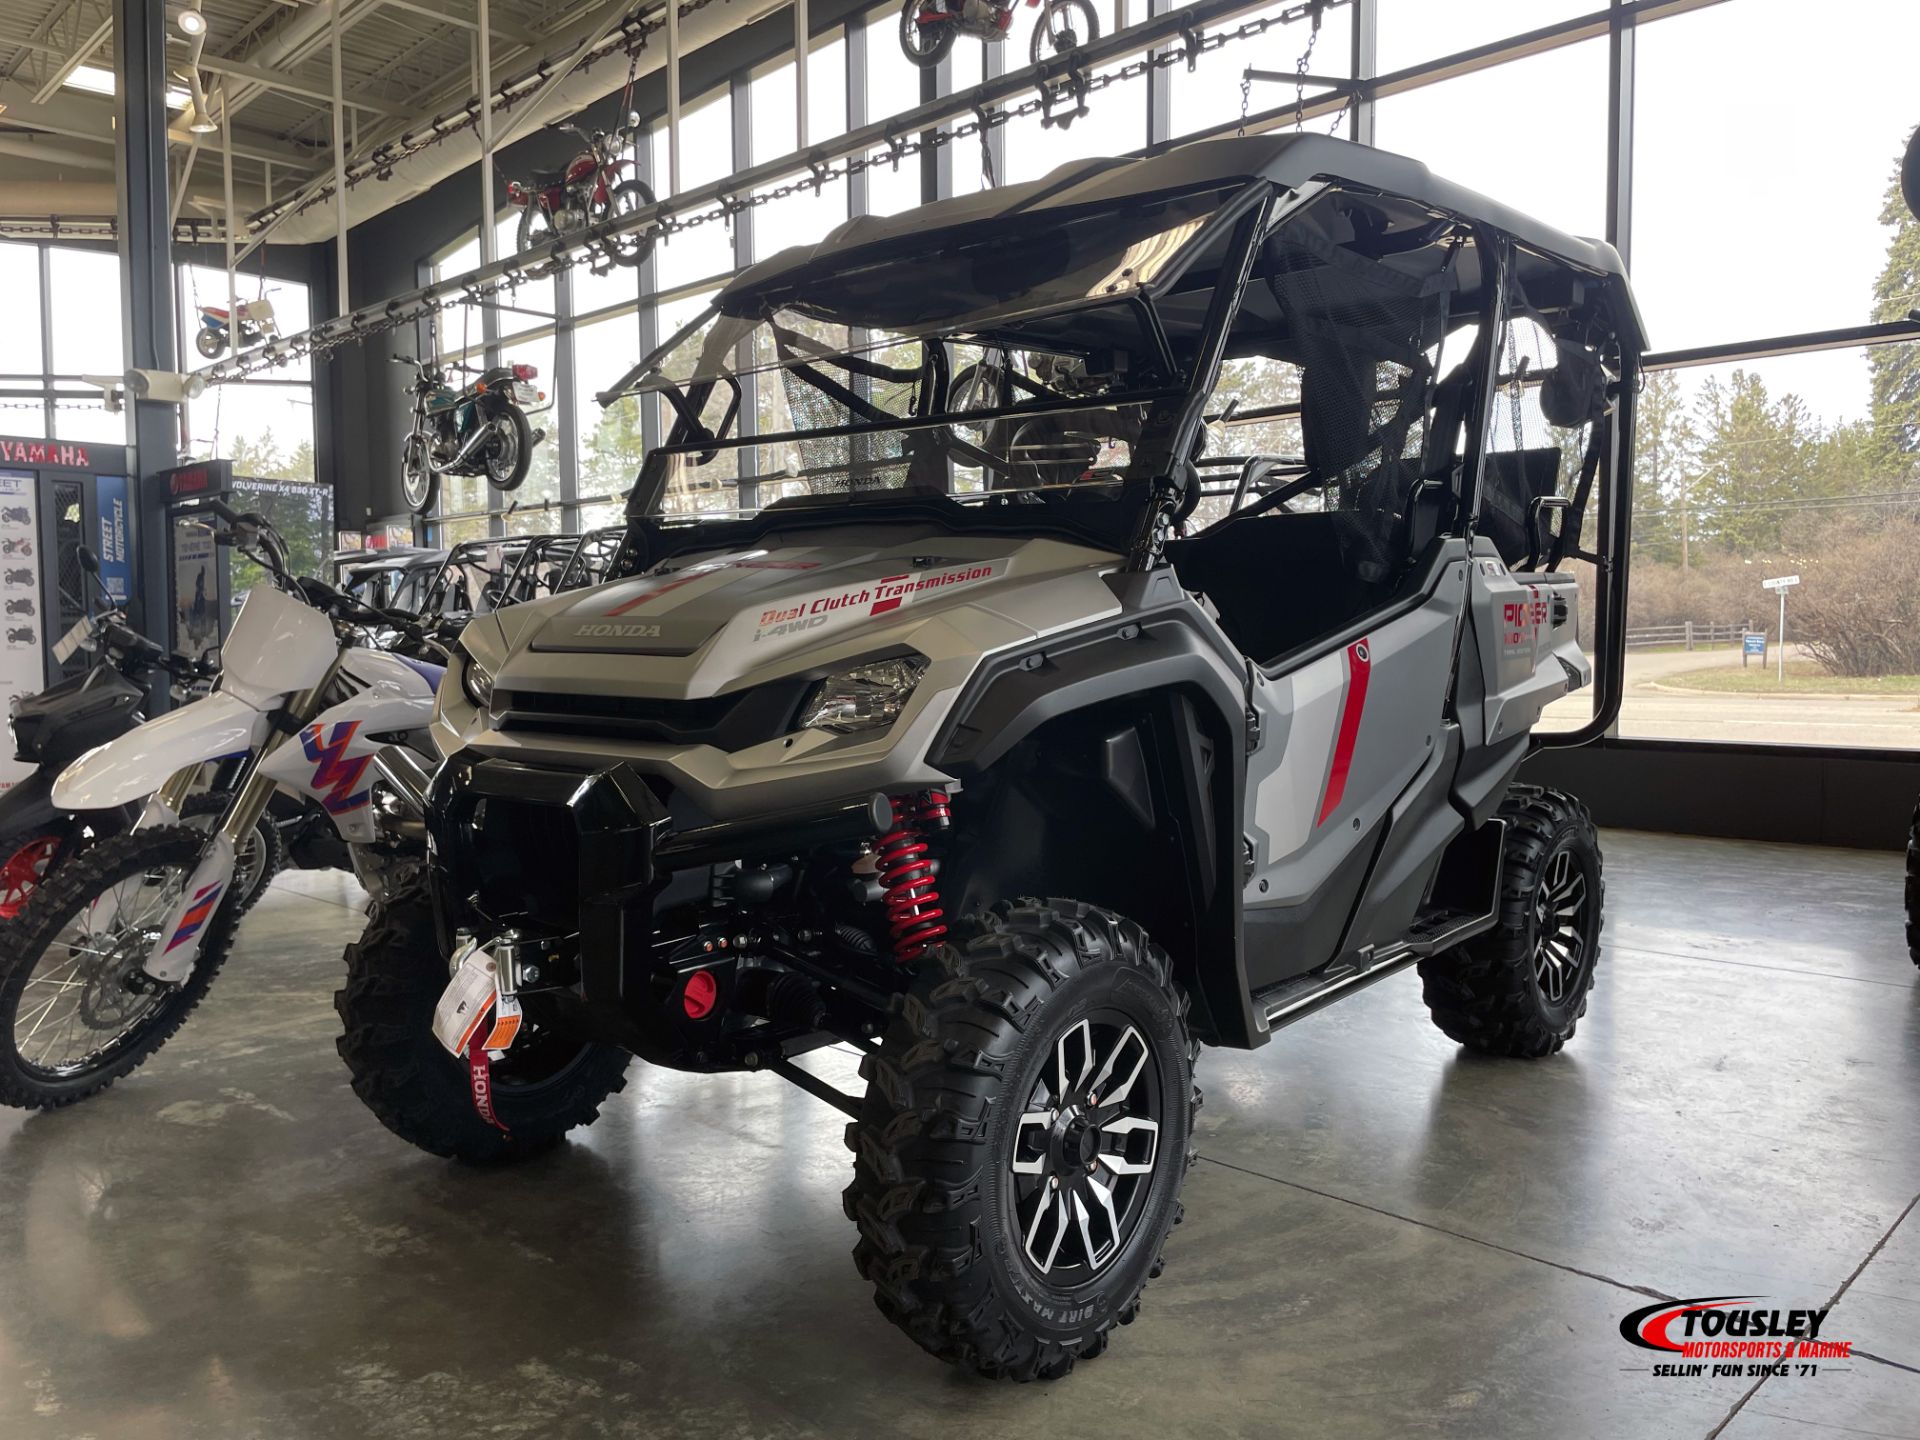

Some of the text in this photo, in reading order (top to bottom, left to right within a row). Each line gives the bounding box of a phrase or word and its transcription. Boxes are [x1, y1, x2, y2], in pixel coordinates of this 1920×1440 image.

[0, 441, 90, 467] YAMAHA
[101, 516, 114, 562] STREET
[113, 498, 125, 563] MOTORCYCLE
[759, 566, 992, 626] Dual Clutch Transmission
[573, 624, 661, 637] HONDA
[752, 614, 828, 643] i-4WD
